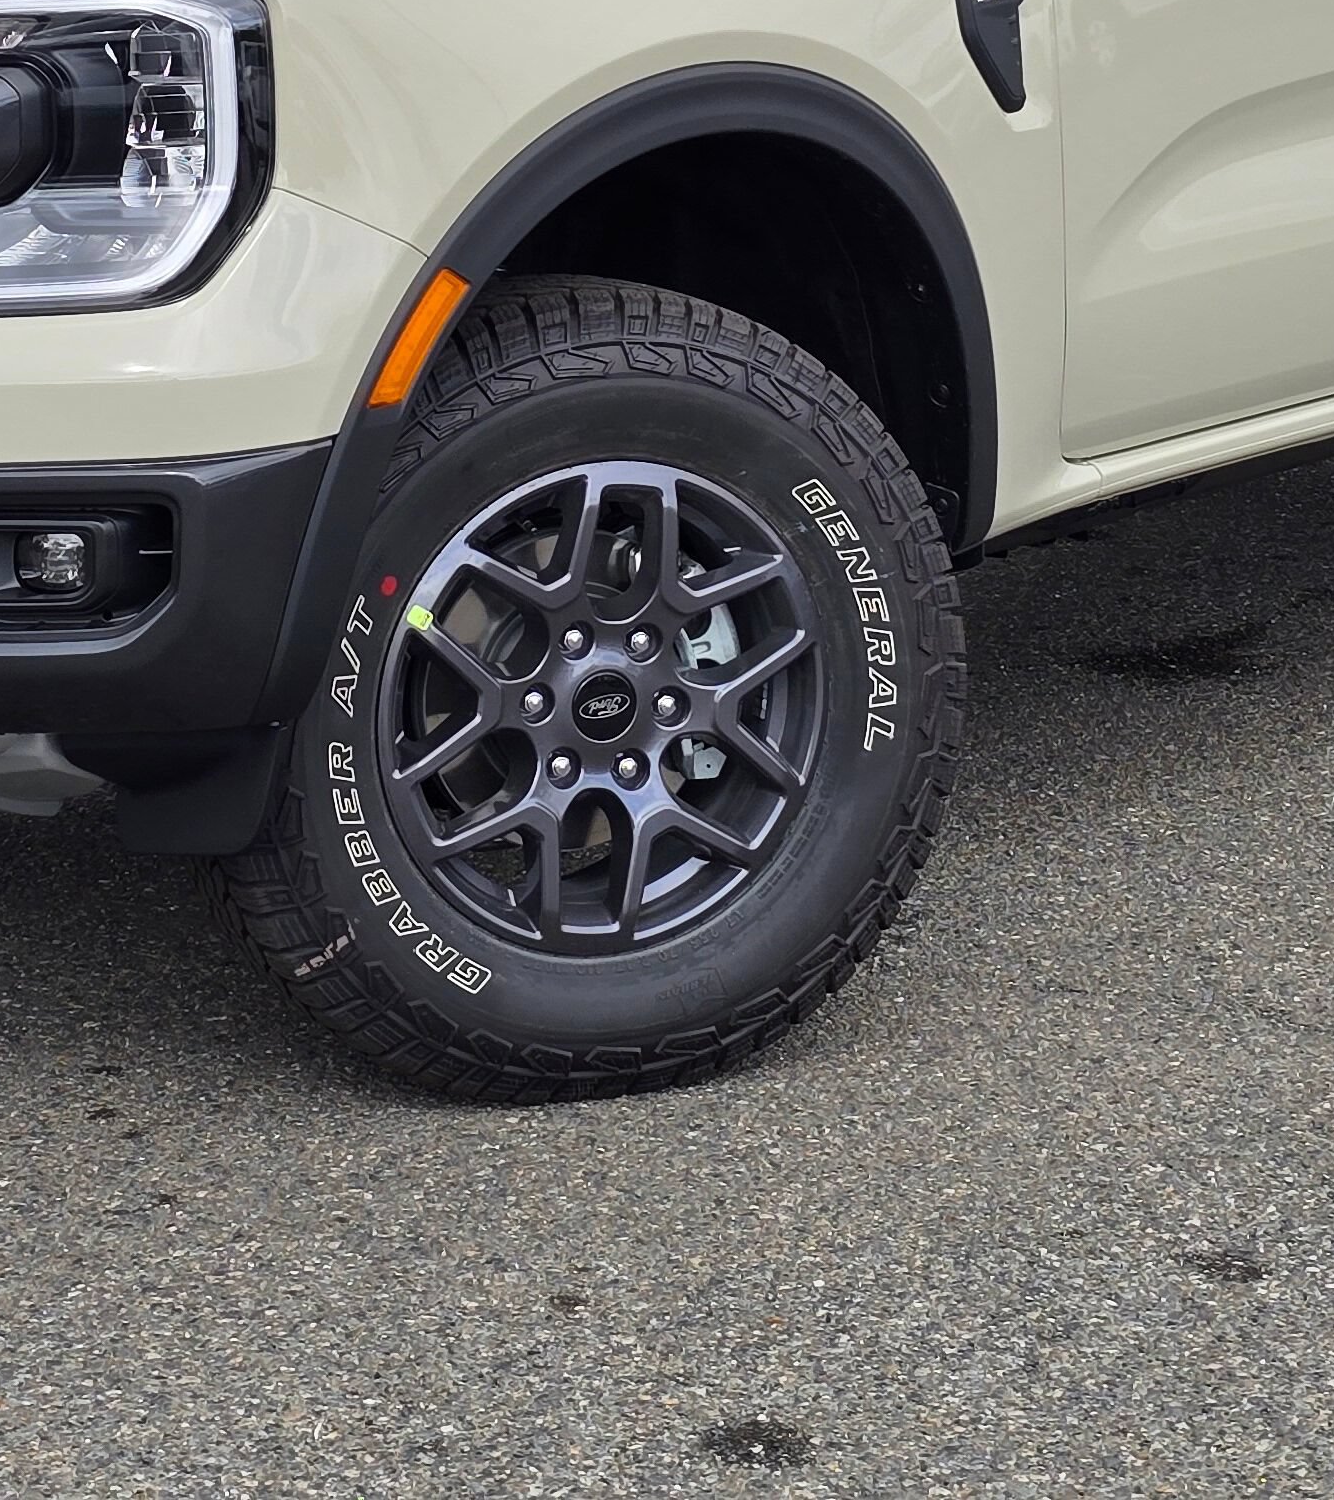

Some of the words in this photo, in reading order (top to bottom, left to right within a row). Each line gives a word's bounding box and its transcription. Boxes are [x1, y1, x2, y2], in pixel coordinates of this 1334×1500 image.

[330, 594, 374, 719] A/T
[588, 696, 622, 716] Ford
[790, 477, 896, 752] GENERAL
[327, 741, 493, 996] GRABBER
